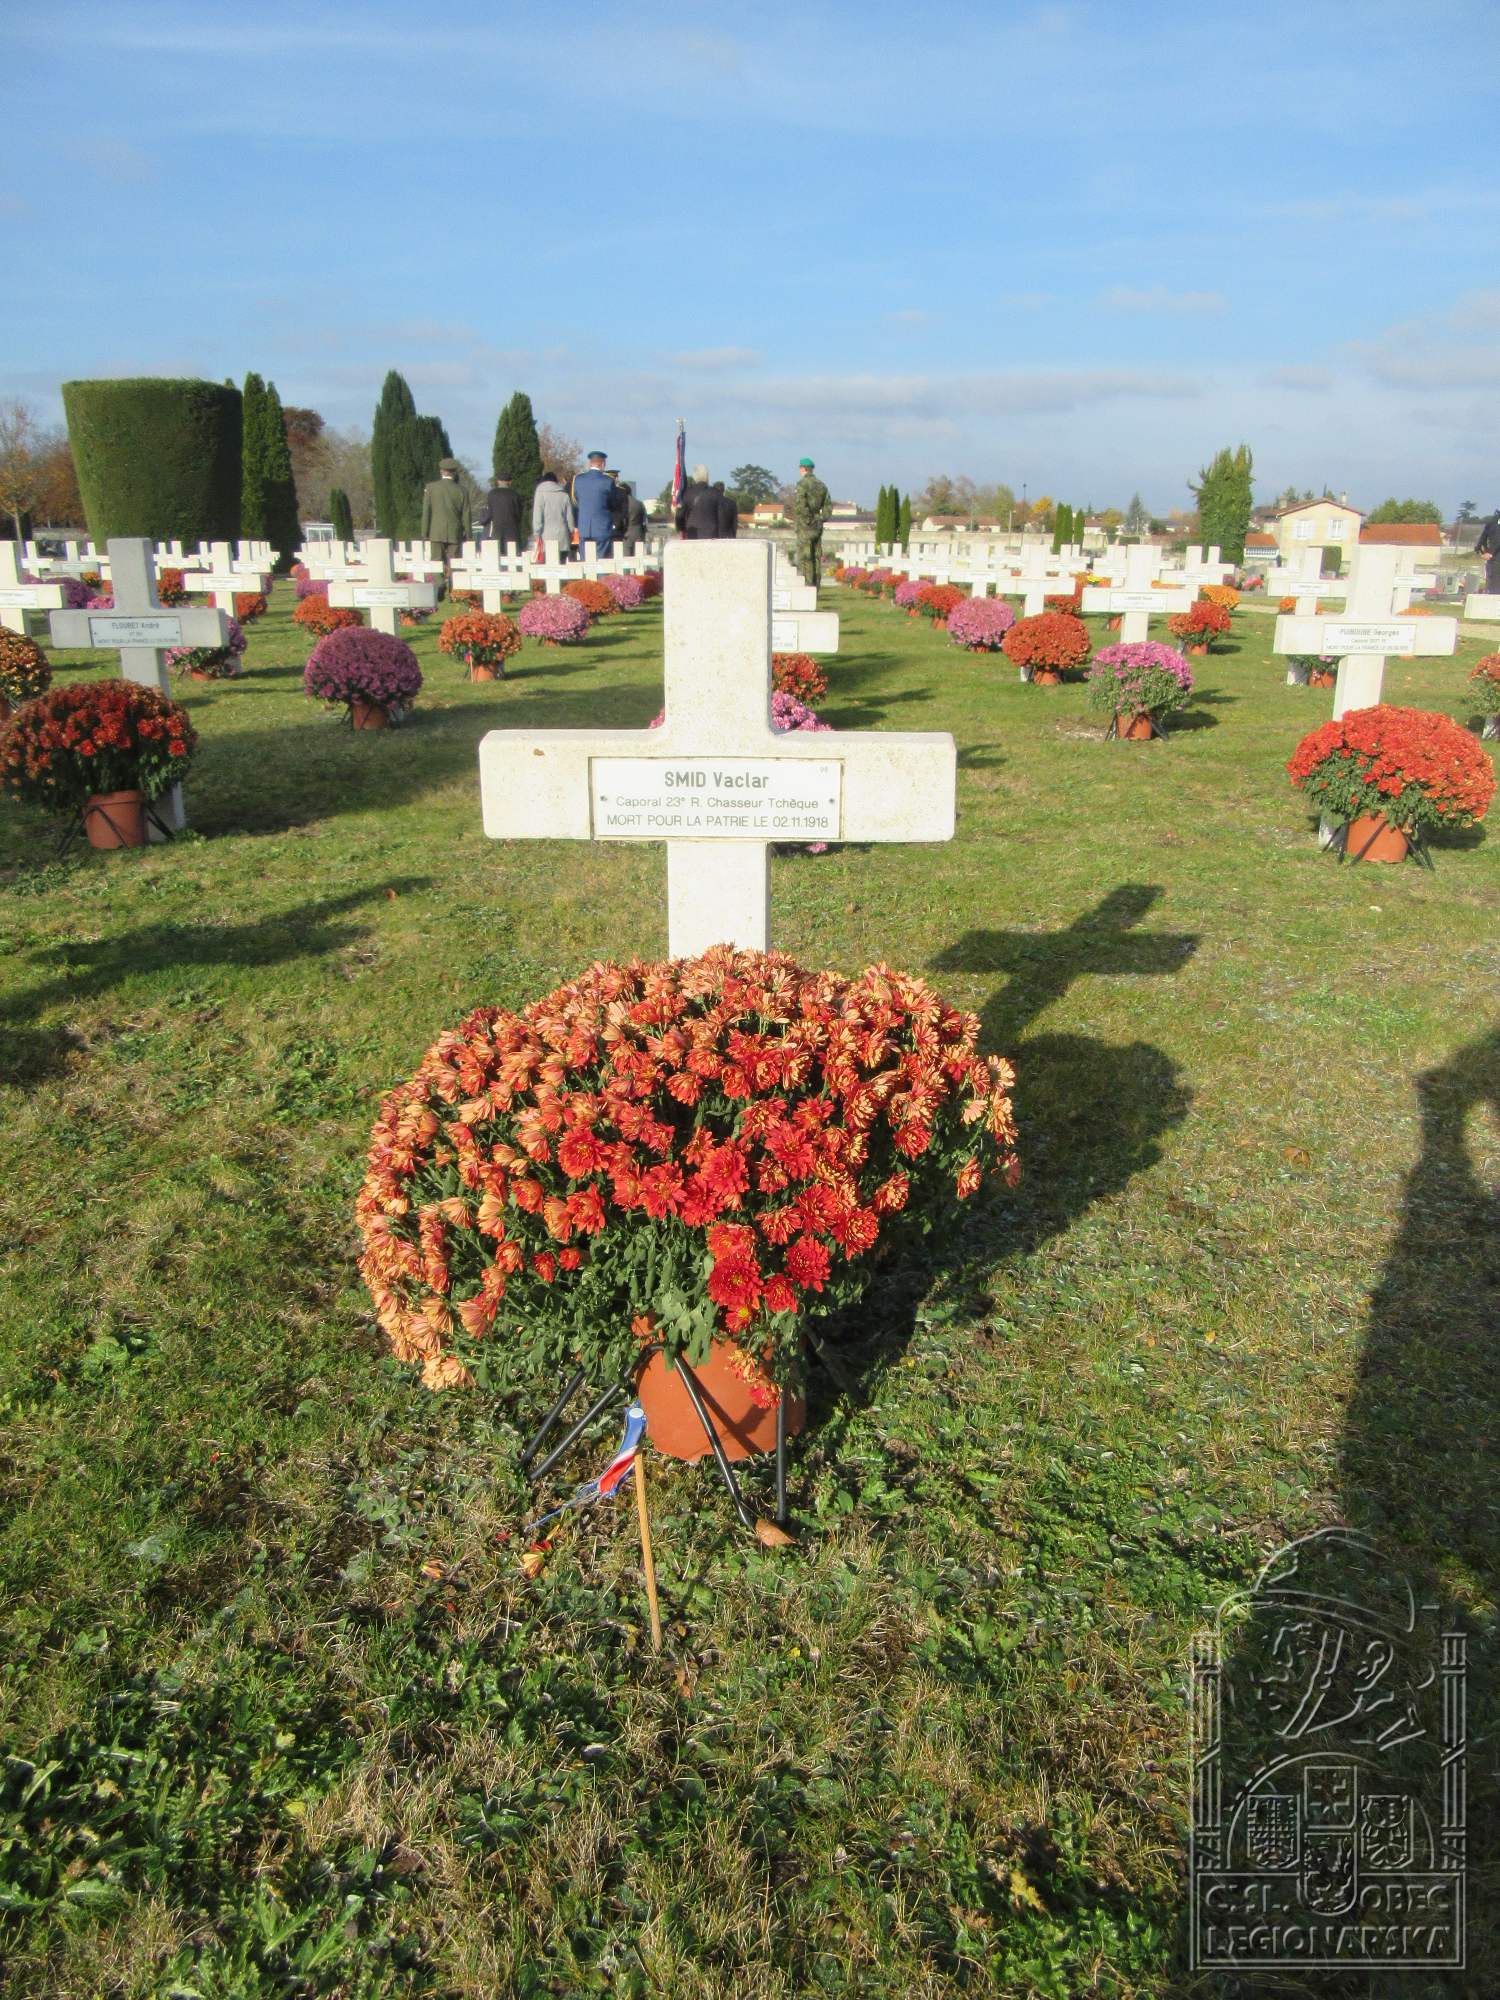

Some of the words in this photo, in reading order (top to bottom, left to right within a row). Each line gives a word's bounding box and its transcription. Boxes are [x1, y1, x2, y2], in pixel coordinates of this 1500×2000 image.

[664, 771, 706, 788] SMID
[713, 771, 769, 788] Vaclar
[615, 795, 662, 808] Caporal
[706, 797, 763, 808] Chasseur
[607, 814, 643, 826] MORT
[647, 815, 682, 826] POUR
[686, 815, 701, 826] LA
[706, 815, 749, 827] PATRIE
[753, 816, 769, 827] LE
[772, 816, 829, 828] 02.11.1918
